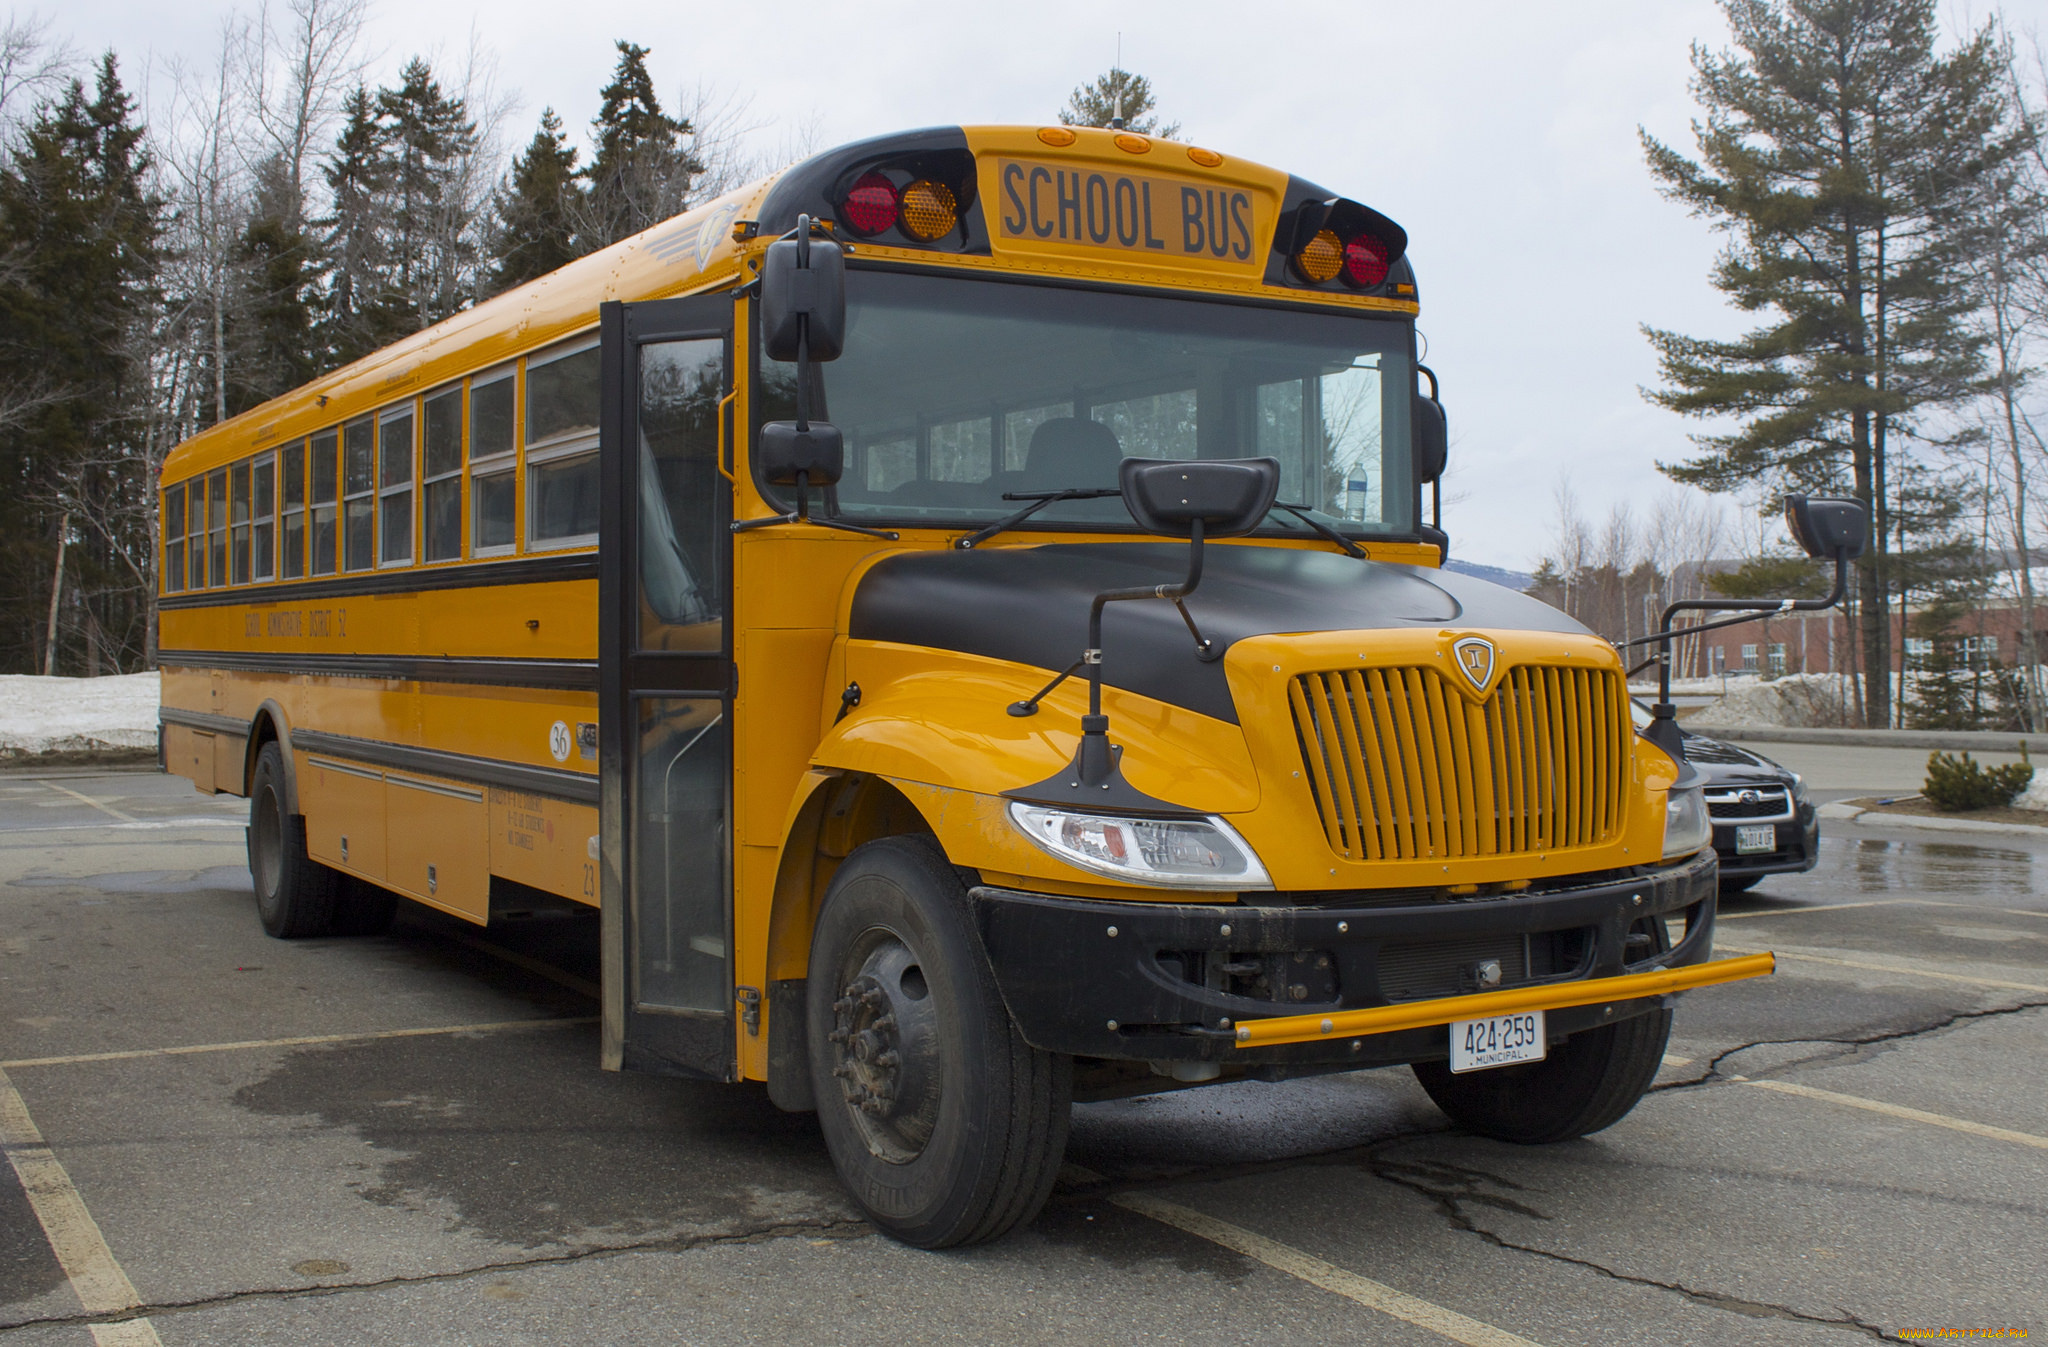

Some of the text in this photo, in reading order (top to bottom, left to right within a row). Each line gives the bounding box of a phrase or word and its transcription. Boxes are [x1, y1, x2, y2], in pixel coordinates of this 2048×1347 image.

[1003, 163, 1251, 260] SCHOOL BUS
[245, 612, 261, 637] SCHOOL
[309, 609, 332, 637] DISTRICT
[553, 726, 567, 756] 36
[583, 863, 595, 897] 23
[1475, 1051, 1524, 1065] MUNICIPAL
